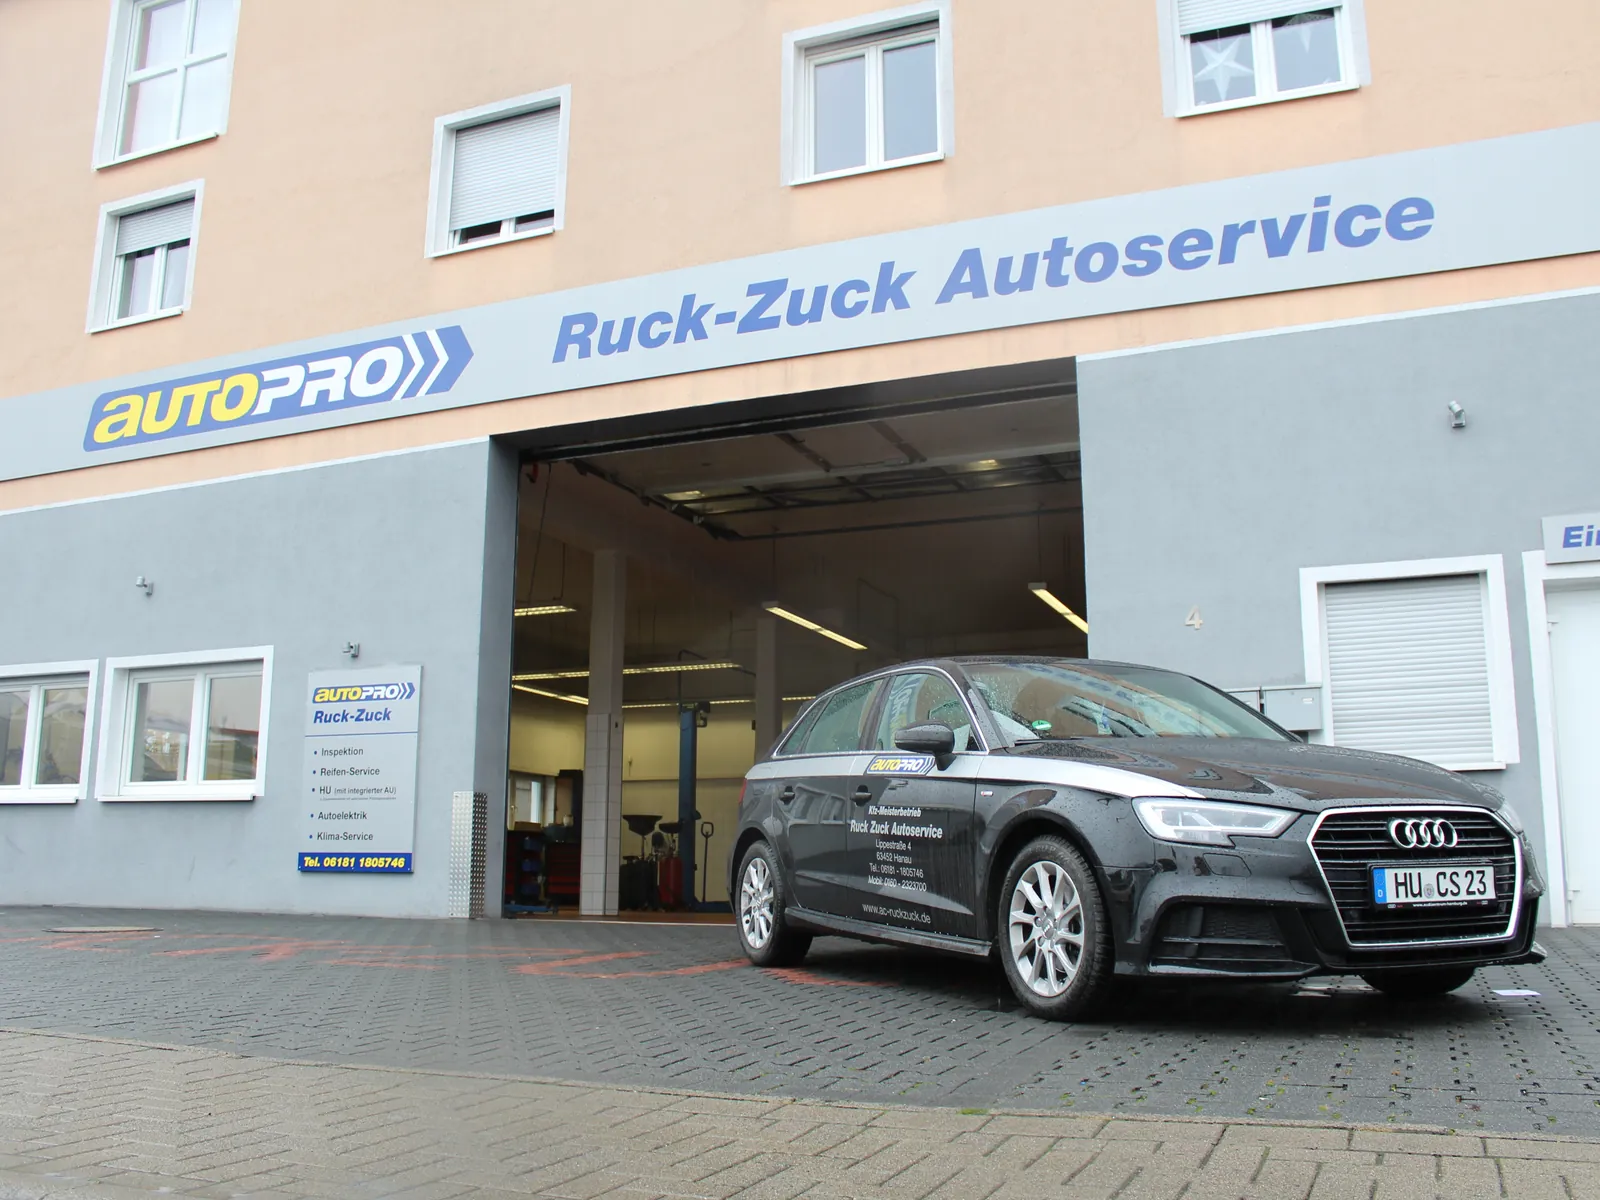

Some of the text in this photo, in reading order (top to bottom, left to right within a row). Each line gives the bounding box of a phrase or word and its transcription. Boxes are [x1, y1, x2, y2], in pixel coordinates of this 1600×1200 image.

[552, 194, 1436, 364] Ruck-Zuck Autoservice
[1184, 604, 1203, 630] 4
[313, 708, 392, 724] Ruck-Zuck
[321, 747, 364, 758] Inspektion
[320, 767, 380, 777] Reifen-Service
[319, 786, 397, 796] HU (mit integrierter AU)
[318, 811, 368, 821] Autoelektrik
[868, 805, 922, 818] Kfz-Meisterbetrieb
[850, 820, 943, 838] Ruck Zuck Autoservice
[317, 832, 374, 842] Klima-Service
[875, 838, 912, 851] Lippestraße 4
[303, 856, 405, 868] Tel. 06181 1805746
[876, 851, 912, 864] 63452 Hanau
[1394, 872, 1423, 899] HU
[1436, 871, 1461, 897] CS
[1465, 869, 1487, 895] 23
